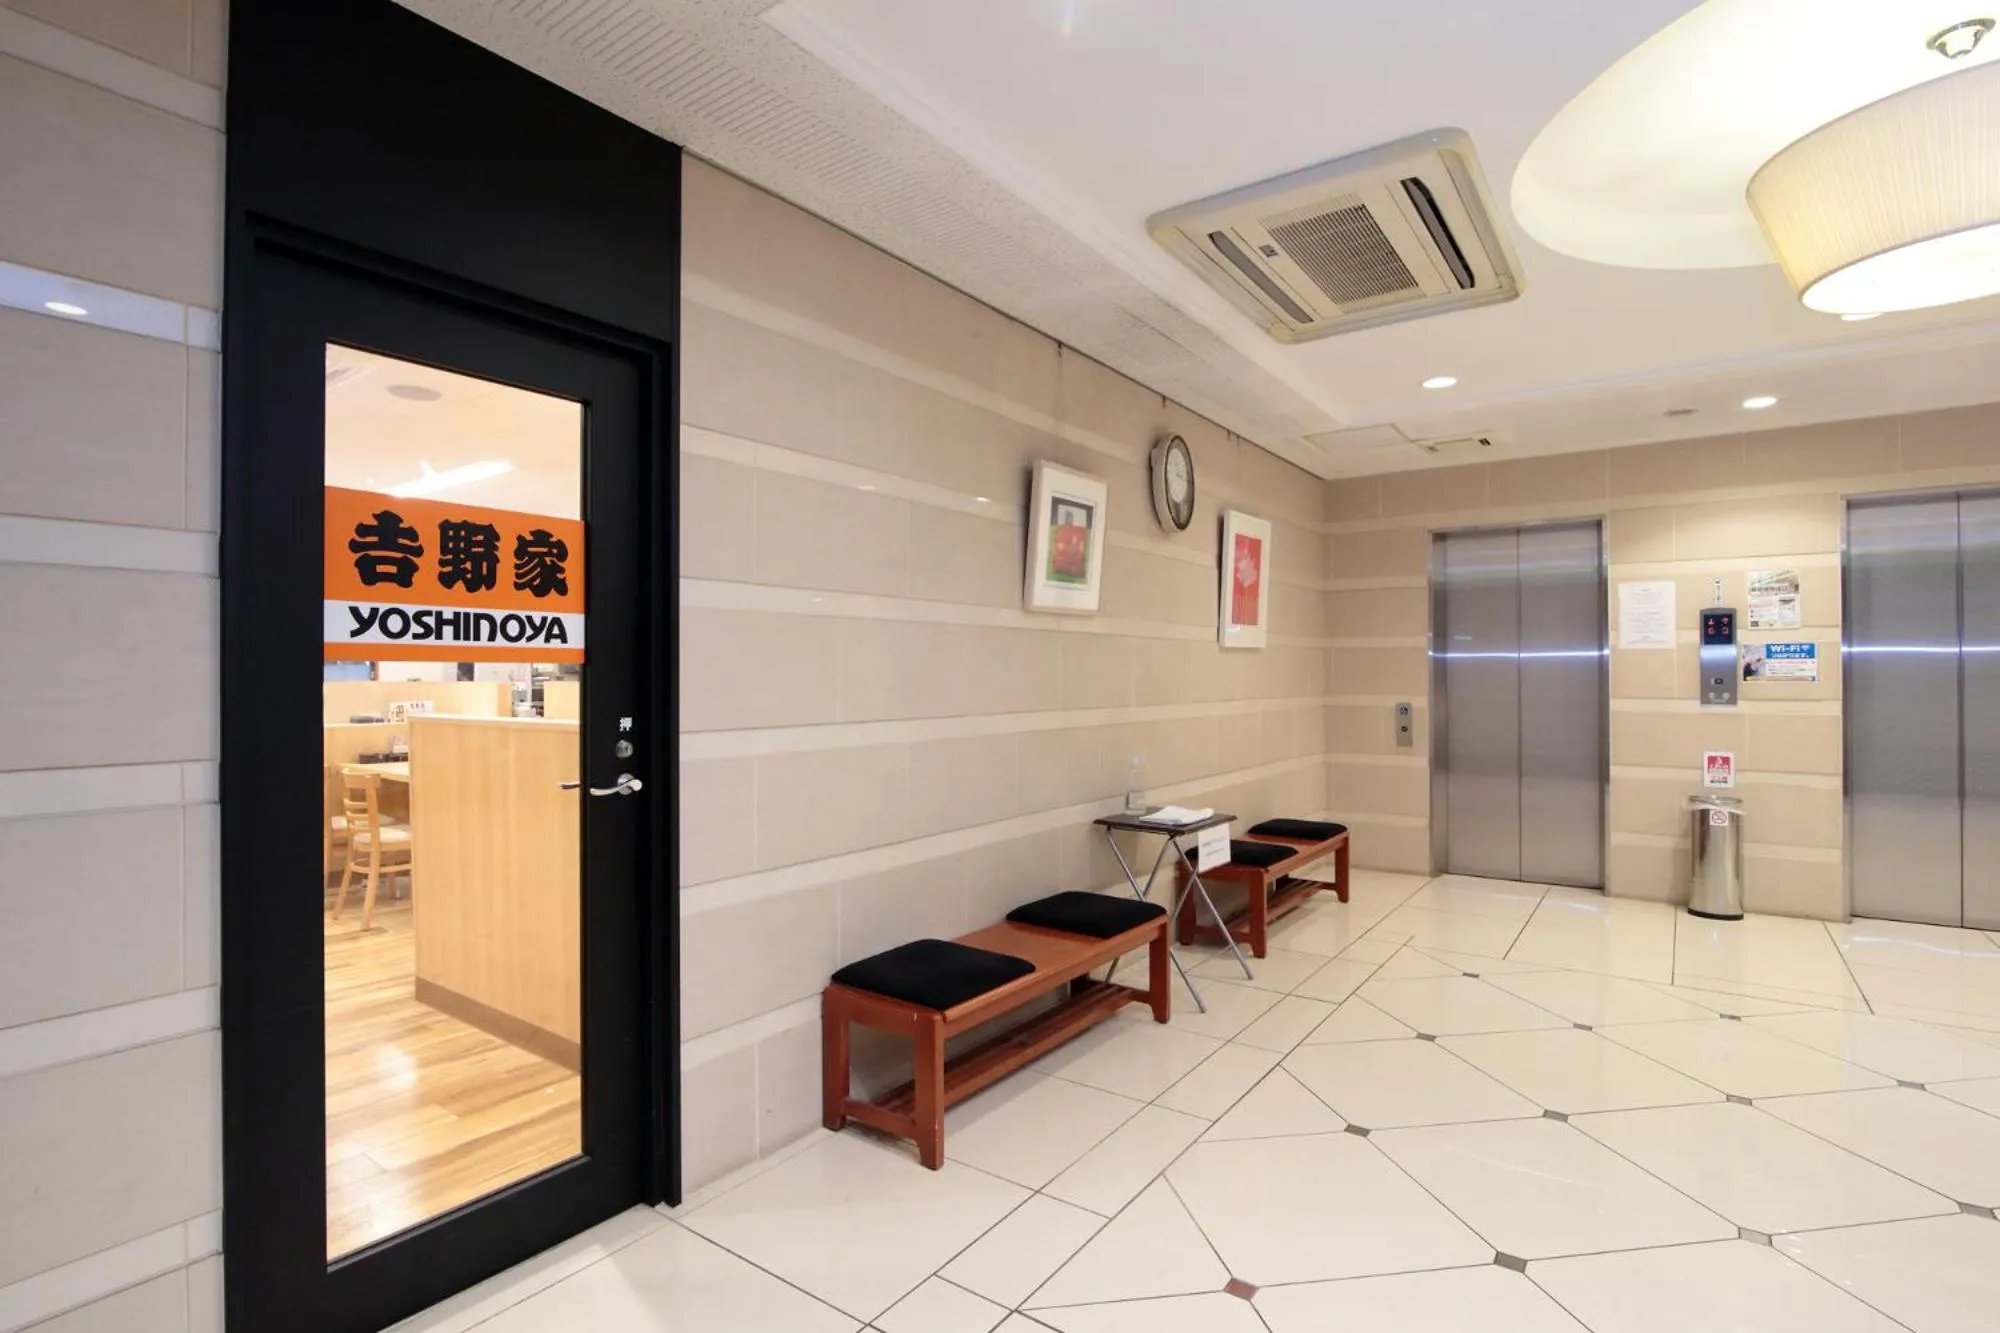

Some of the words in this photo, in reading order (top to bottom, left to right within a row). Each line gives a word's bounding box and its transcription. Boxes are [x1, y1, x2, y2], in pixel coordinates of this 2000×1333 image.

[348, 509, 568, 598] 吉野家
[348, 605, 568, 645] YOSHINOYA
[619, 716, 633, 732] 押
